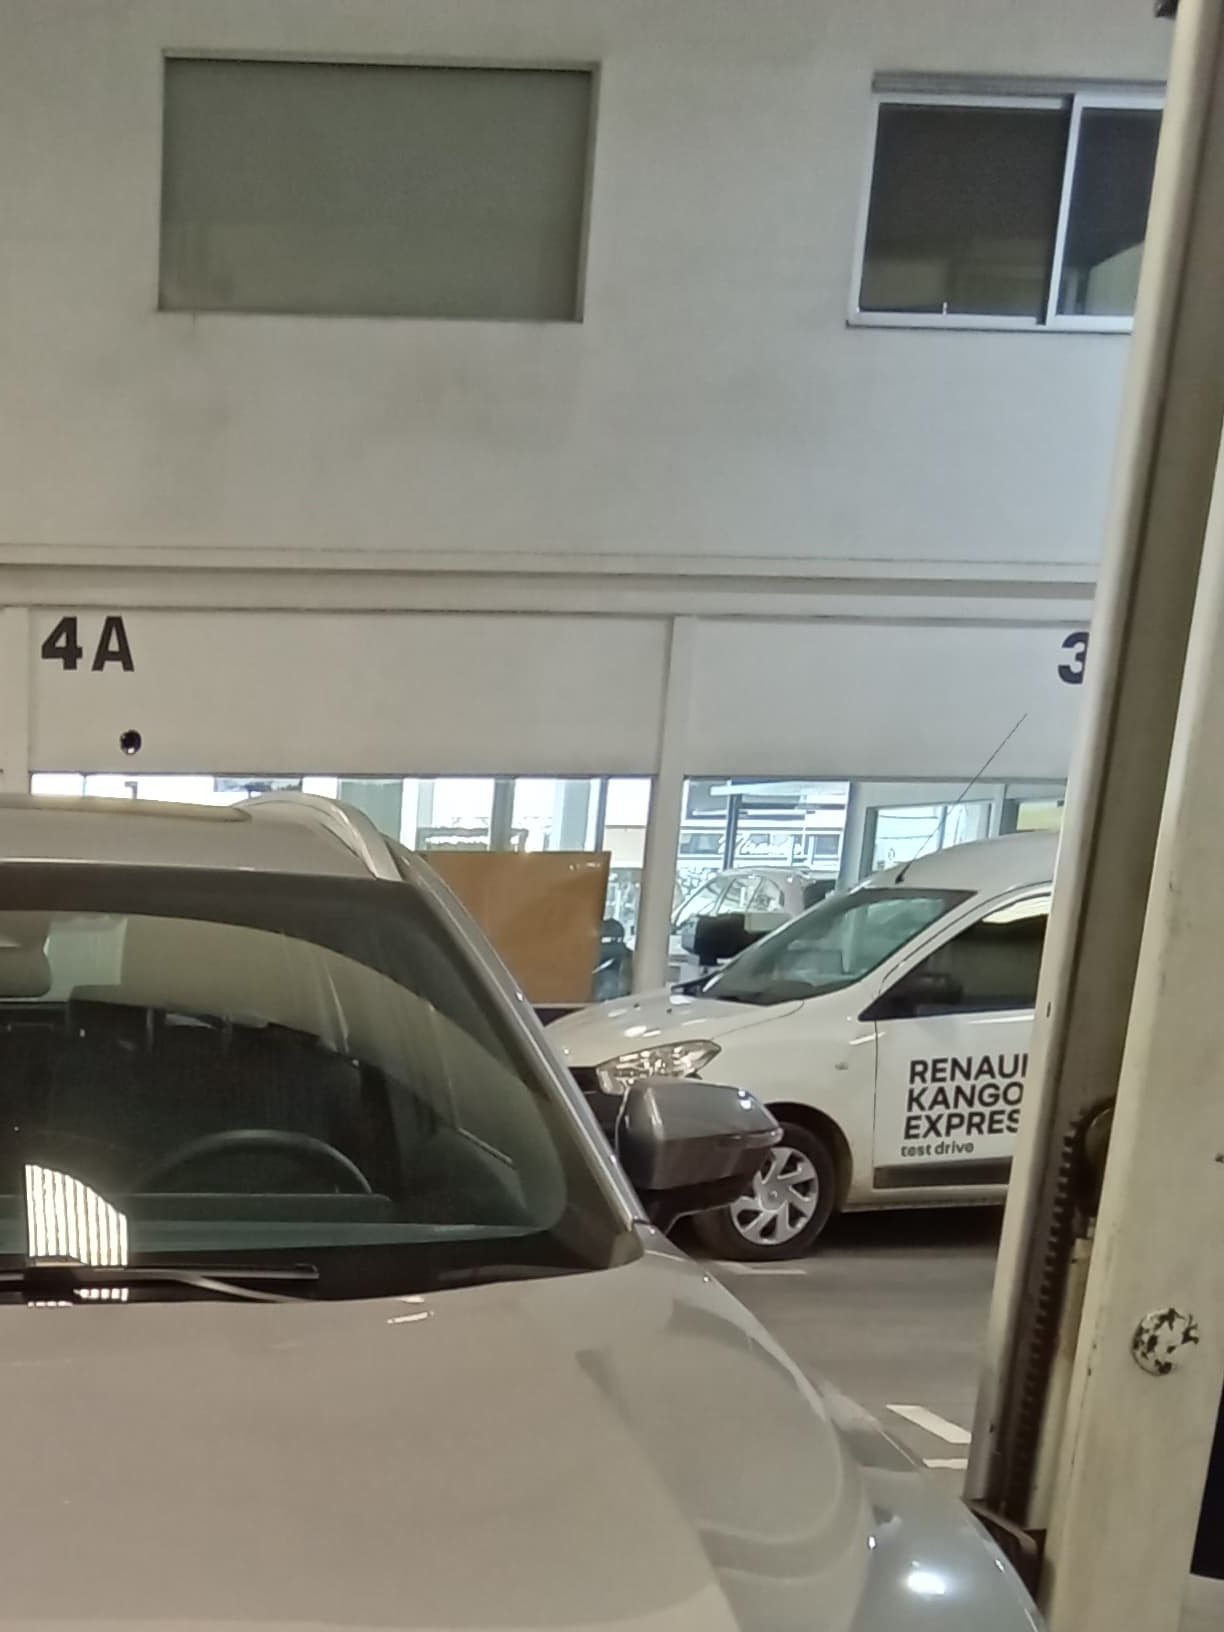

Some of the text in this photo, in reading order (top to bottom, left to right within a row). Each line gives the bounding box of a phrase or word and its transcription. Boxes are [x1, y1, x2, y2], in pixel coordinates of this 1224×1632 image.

[41, 615, 135, 672] 4A
[901, 1139, 974, 1157] test drive
